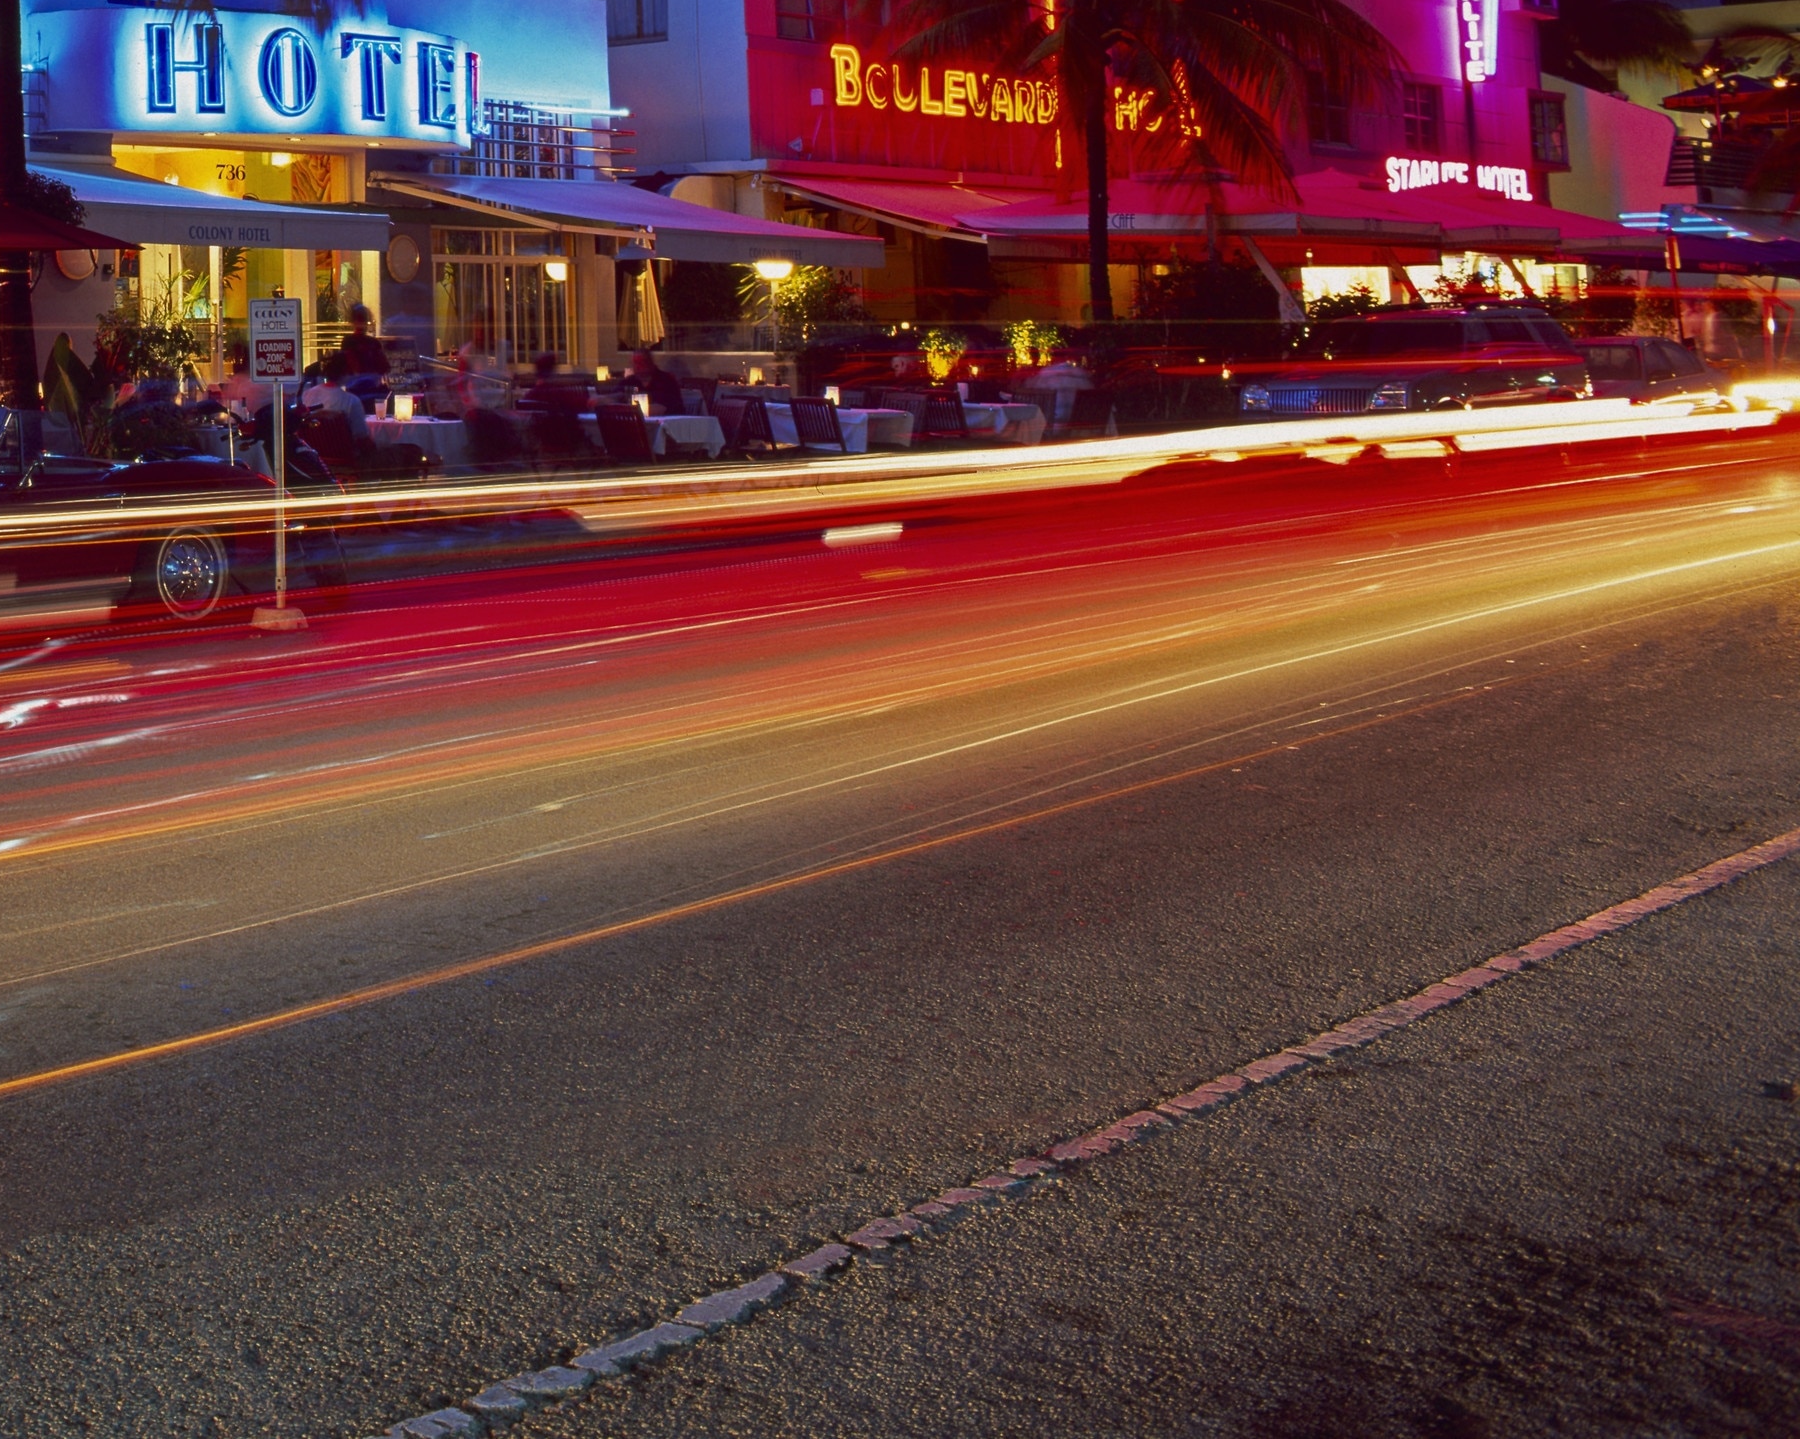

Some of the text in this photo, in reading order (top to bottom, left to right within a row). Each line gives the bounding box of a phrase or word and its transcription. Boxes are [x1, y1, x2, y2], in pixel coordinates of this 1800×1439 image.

[146, 22, 491, 136] HOTEL
[830, 44, 1059, 125] BOULEVARD
[215, 164, 246, 181] 736
[1476, 164, 1533, 201] HOTEL
[1111, 213, 1136, 229] CAFE
[188, 225, 271, 242] COLONY HOTEL
[254, 309, 293, 319] COLONY
[261, 321, 289, 331] HOTEL
[258, 342, 292, 353] LOADING
